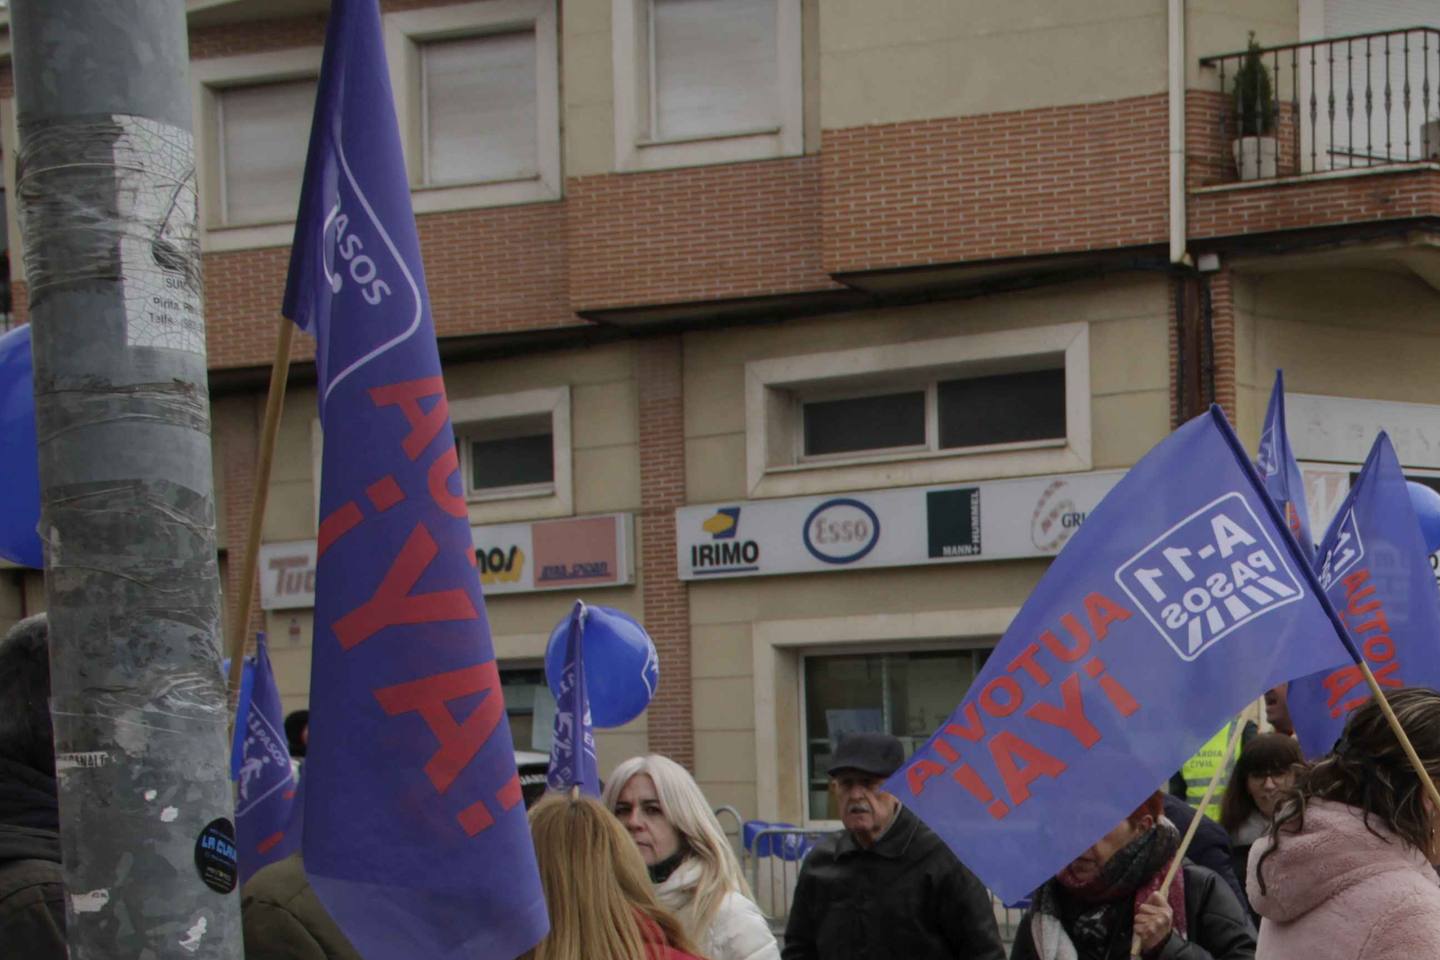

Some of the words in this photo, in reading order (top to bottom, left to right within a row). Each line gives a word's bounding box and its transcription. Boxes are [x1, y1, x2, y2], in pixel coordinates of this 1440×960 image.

[333, 212, 392, 305] ASOS
[814, 517, 868, 545] Esso
[970, 490, 980, 544] HUMMEL
[692, 541, 759, 567] IRIMO
